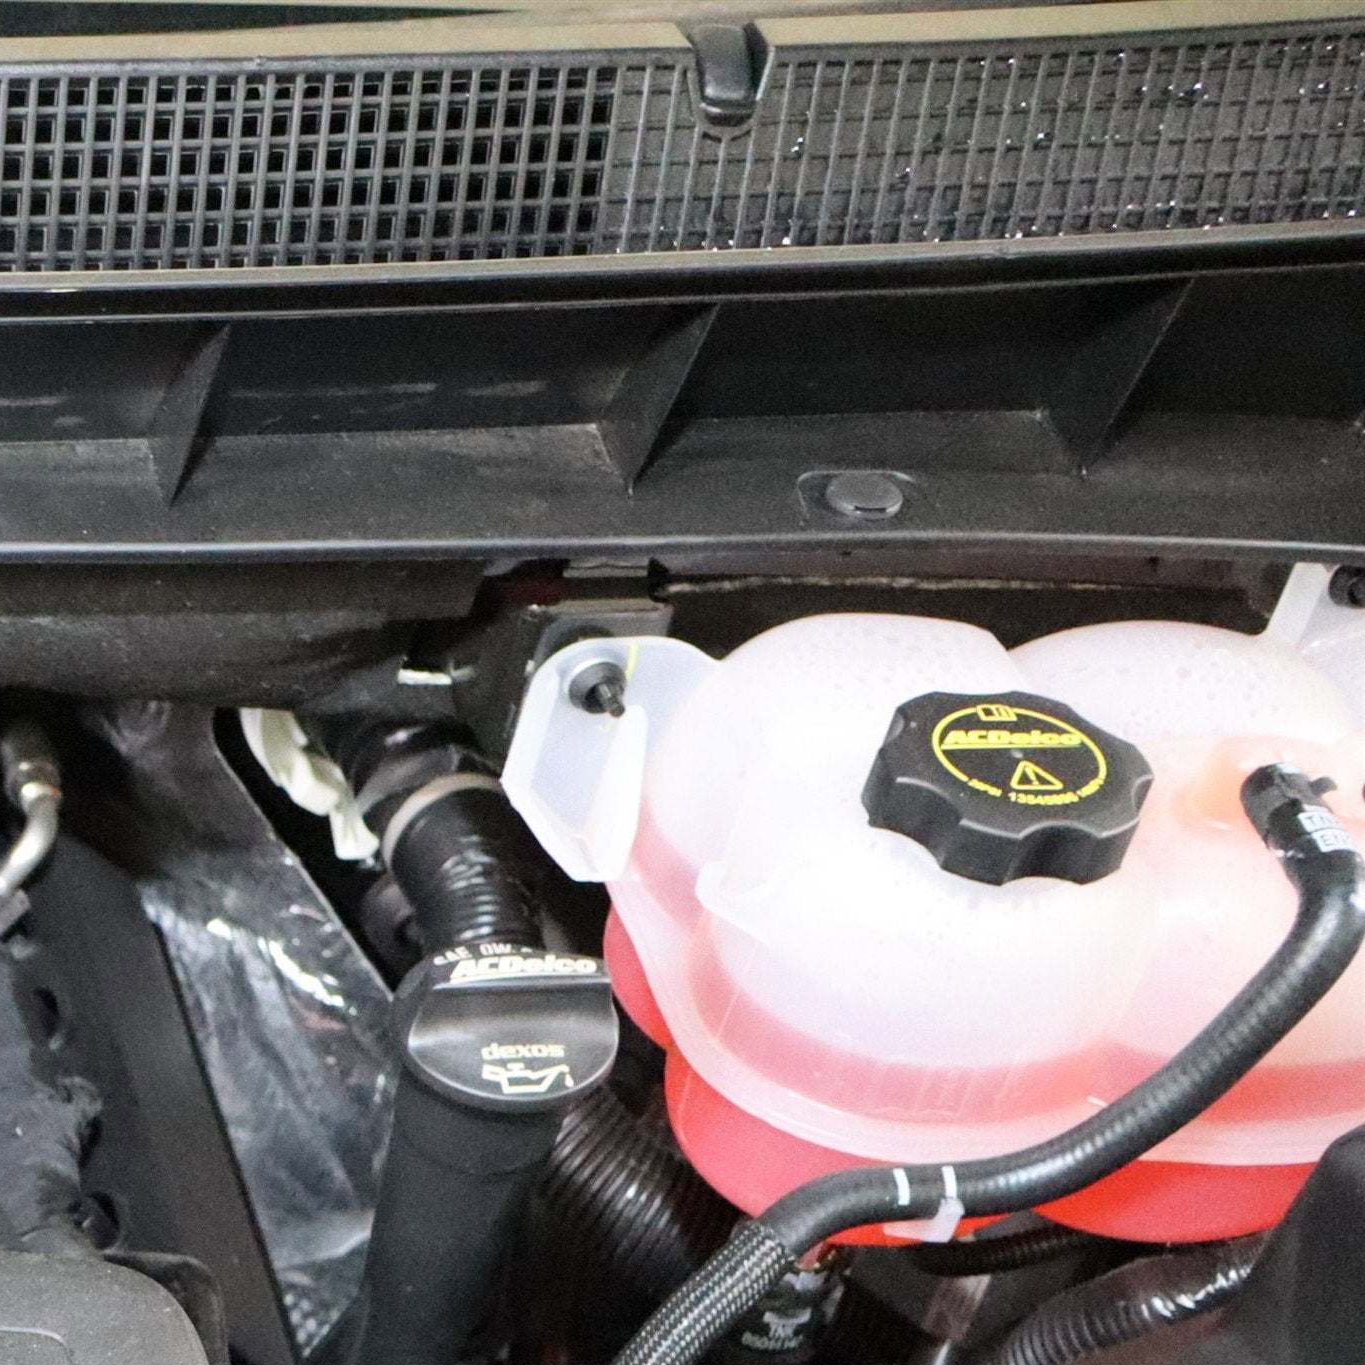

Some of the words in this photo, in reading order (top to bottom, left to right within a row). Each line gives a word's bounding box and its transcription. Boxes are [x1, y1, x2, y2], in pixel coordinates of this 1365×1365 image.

[941, 730, 1082, 746] ACDelco
[449, 954, 598, 980] ACDelco
[481, 1042, 566, 1060] dexos
